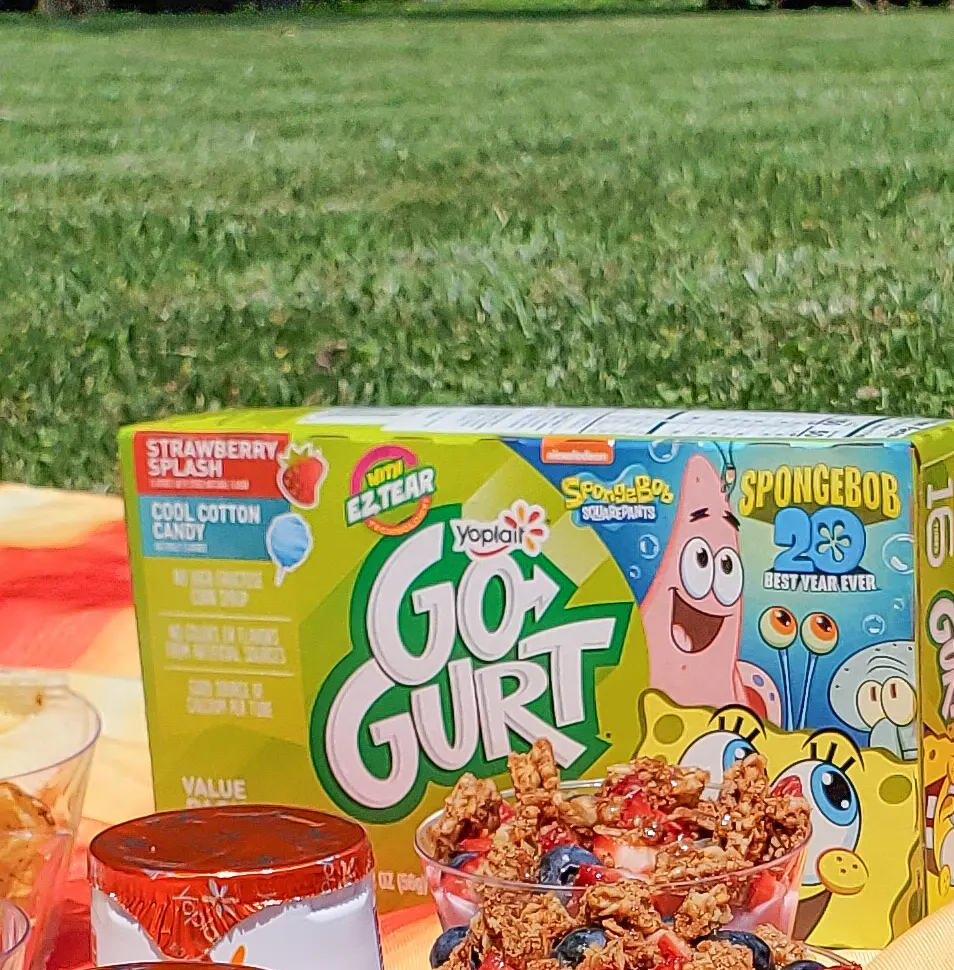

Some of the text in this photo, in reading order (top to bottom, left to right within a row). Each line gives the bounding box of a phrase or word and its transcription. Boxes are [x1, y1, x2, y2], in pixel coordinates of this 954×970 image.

[146, 438, 278, 460] STRAWBERRY
[148, 458, 223, 478] SPLASH
[366, 459, 404, 487] WITH
[346, 468, 435, 524] EZ TEAR
[740, 464, 901, 519] SPONGEBOB
[151, 502, 260, 525] COOL COTTON
[582, 505, 656, 521] SQUAREPANTS
[152, 522, 205, 542] CANDY
[773, 506, 867, 575] 20
[764, 573, 878, 592] BEST YEAR EVER
[366, 522, 540, 687] GO
[326, 617, 618, 810] GURT
[181, 775, 247, 801] VALUE
